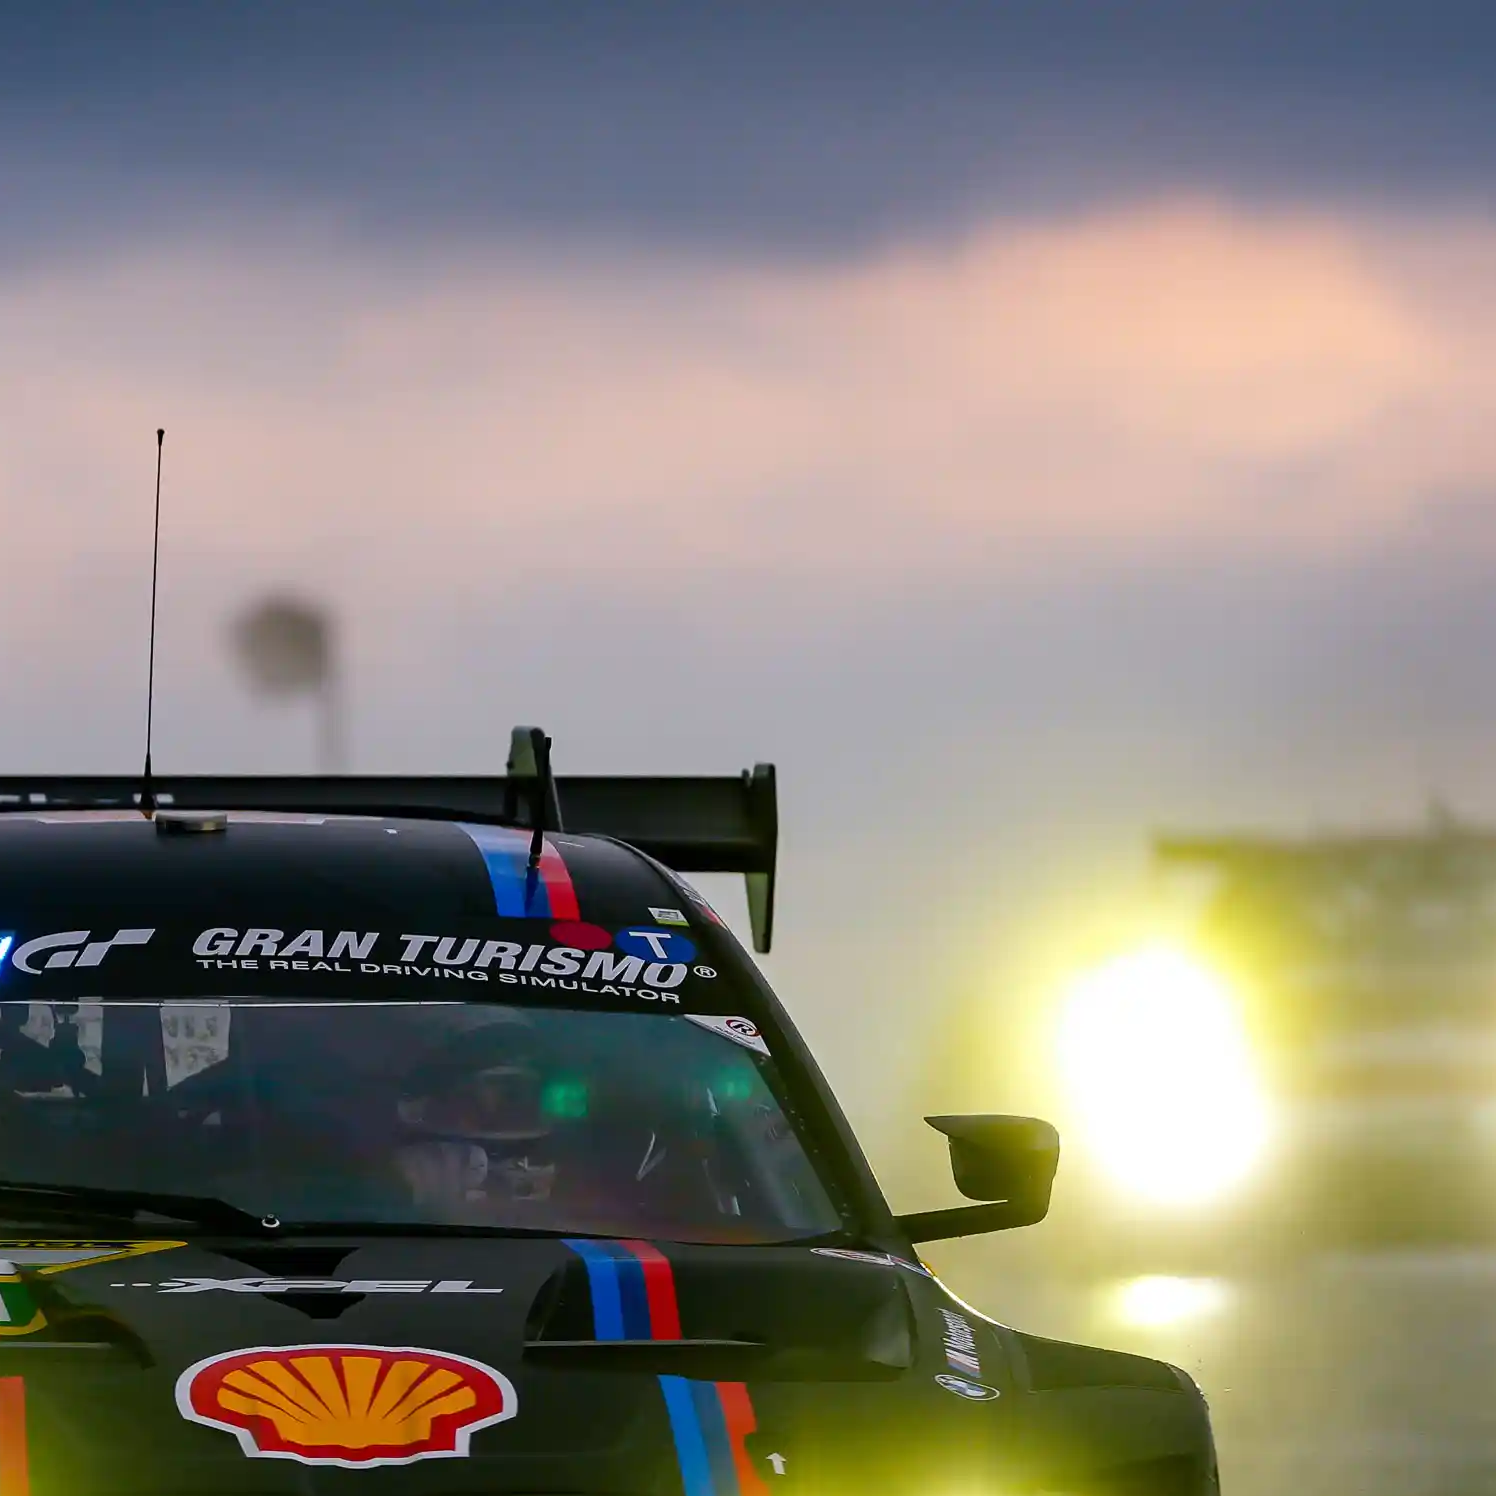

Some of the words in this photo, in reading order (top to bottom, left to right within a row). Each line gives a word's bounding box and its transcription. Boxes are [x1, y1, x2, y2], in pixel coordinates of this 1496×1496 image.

[192, 927, 380, 959] GRAN
[628, 931, 672, 959] T
[196, 959, 260, 969] THE
[269, 960, 352, 972] REAL
[360, 963, 489, 981] DRIVING
[499, 973, 681, 1004] SIMULATOR
[155, 1277, 504, 1293] XPEL
